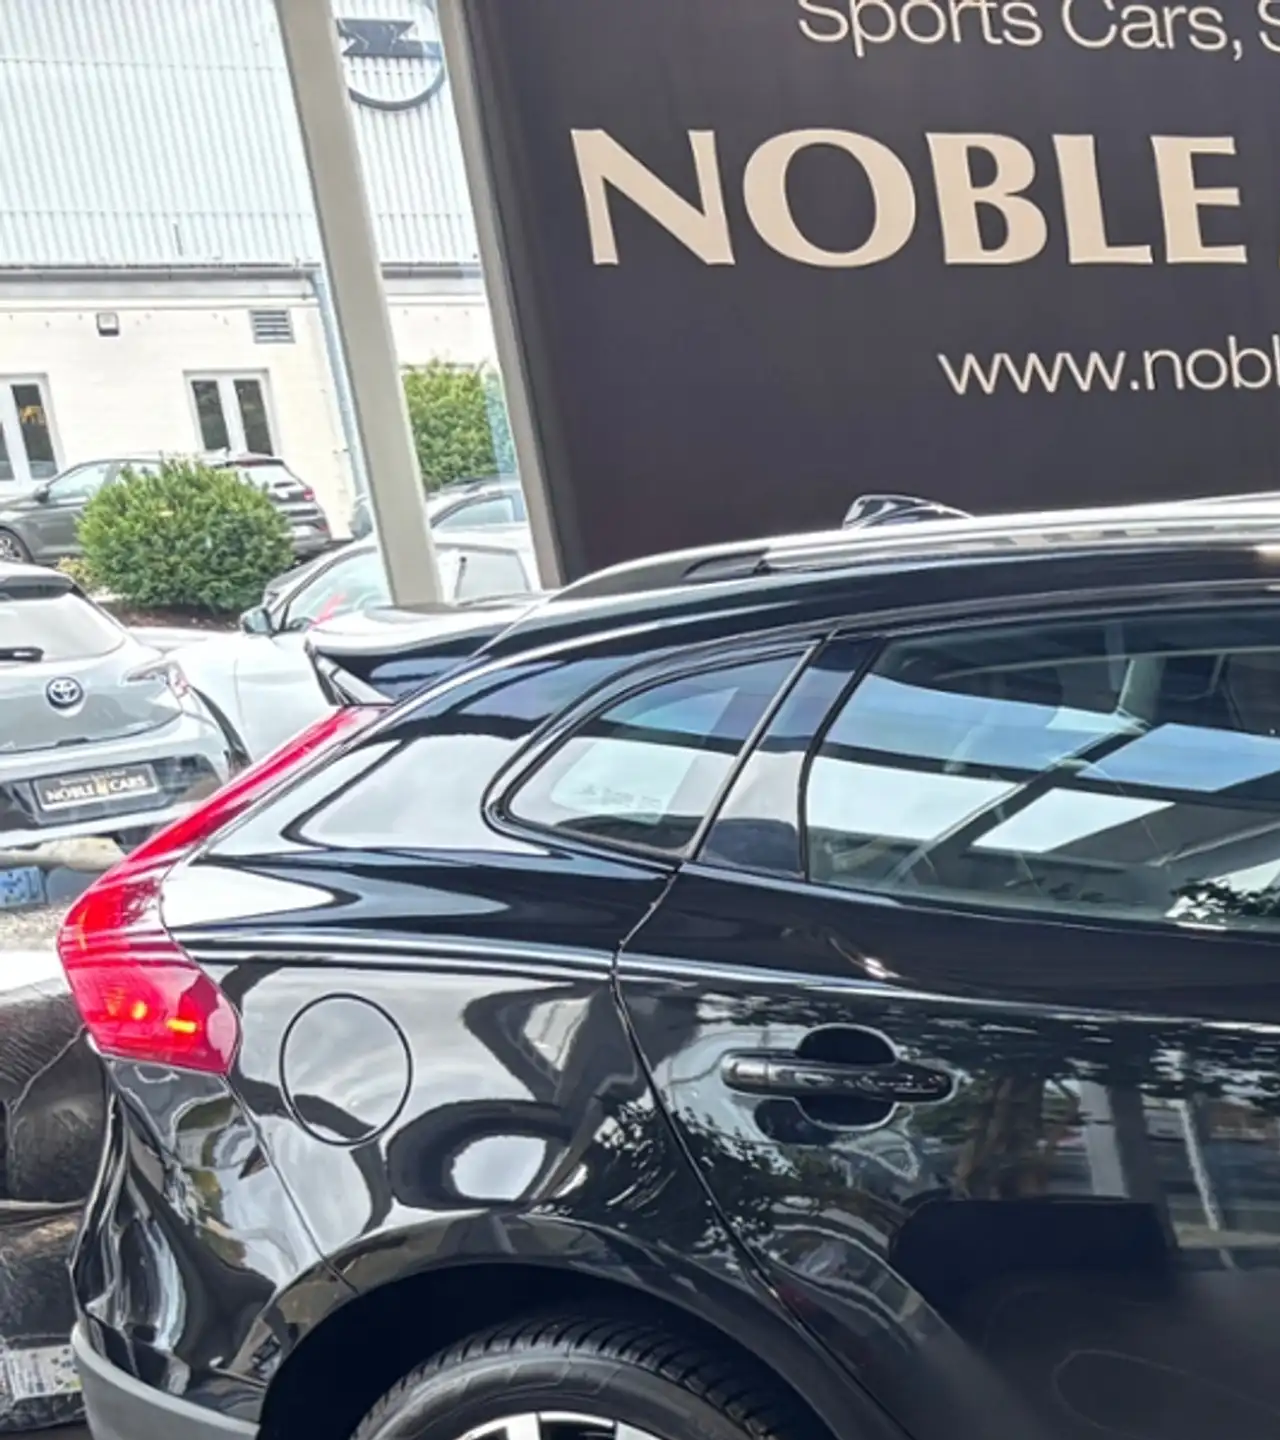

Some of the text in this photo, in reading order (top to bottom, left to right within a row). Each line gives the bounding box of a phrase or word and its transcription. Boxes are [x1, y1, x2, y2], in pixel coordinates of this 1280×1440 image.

[798, 0, 1042, 57] Sports
[1061, 0, 1243, 61] Cars,
[570, 129, 1248, 267] NOBLE
